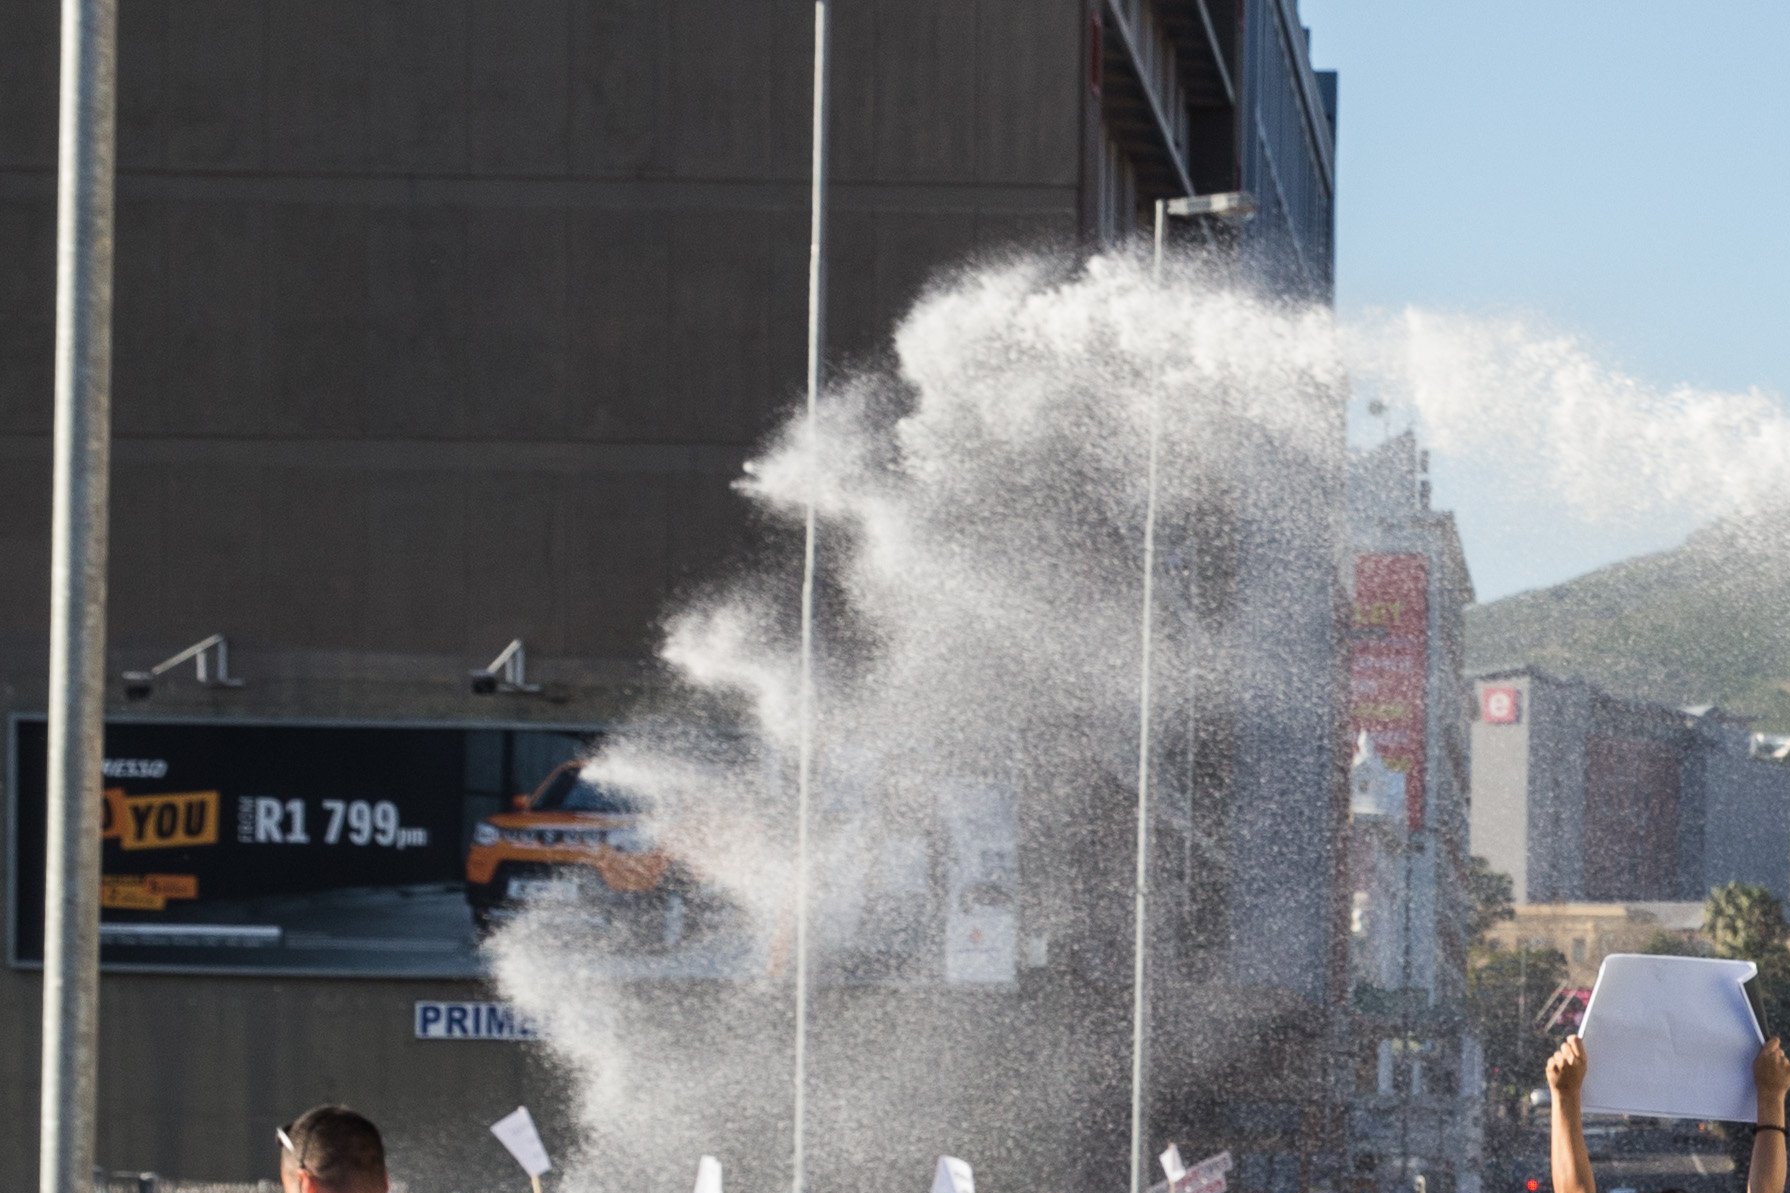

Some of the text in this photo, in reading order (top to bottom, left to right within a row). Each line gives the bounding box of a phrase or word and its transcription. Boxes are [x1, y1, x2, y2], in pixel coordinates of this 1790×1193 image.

[132, 801, 207, 842] YOU
[255, 796, 310, 844] R1
[420, 1005, 538, 1036] PRIM
